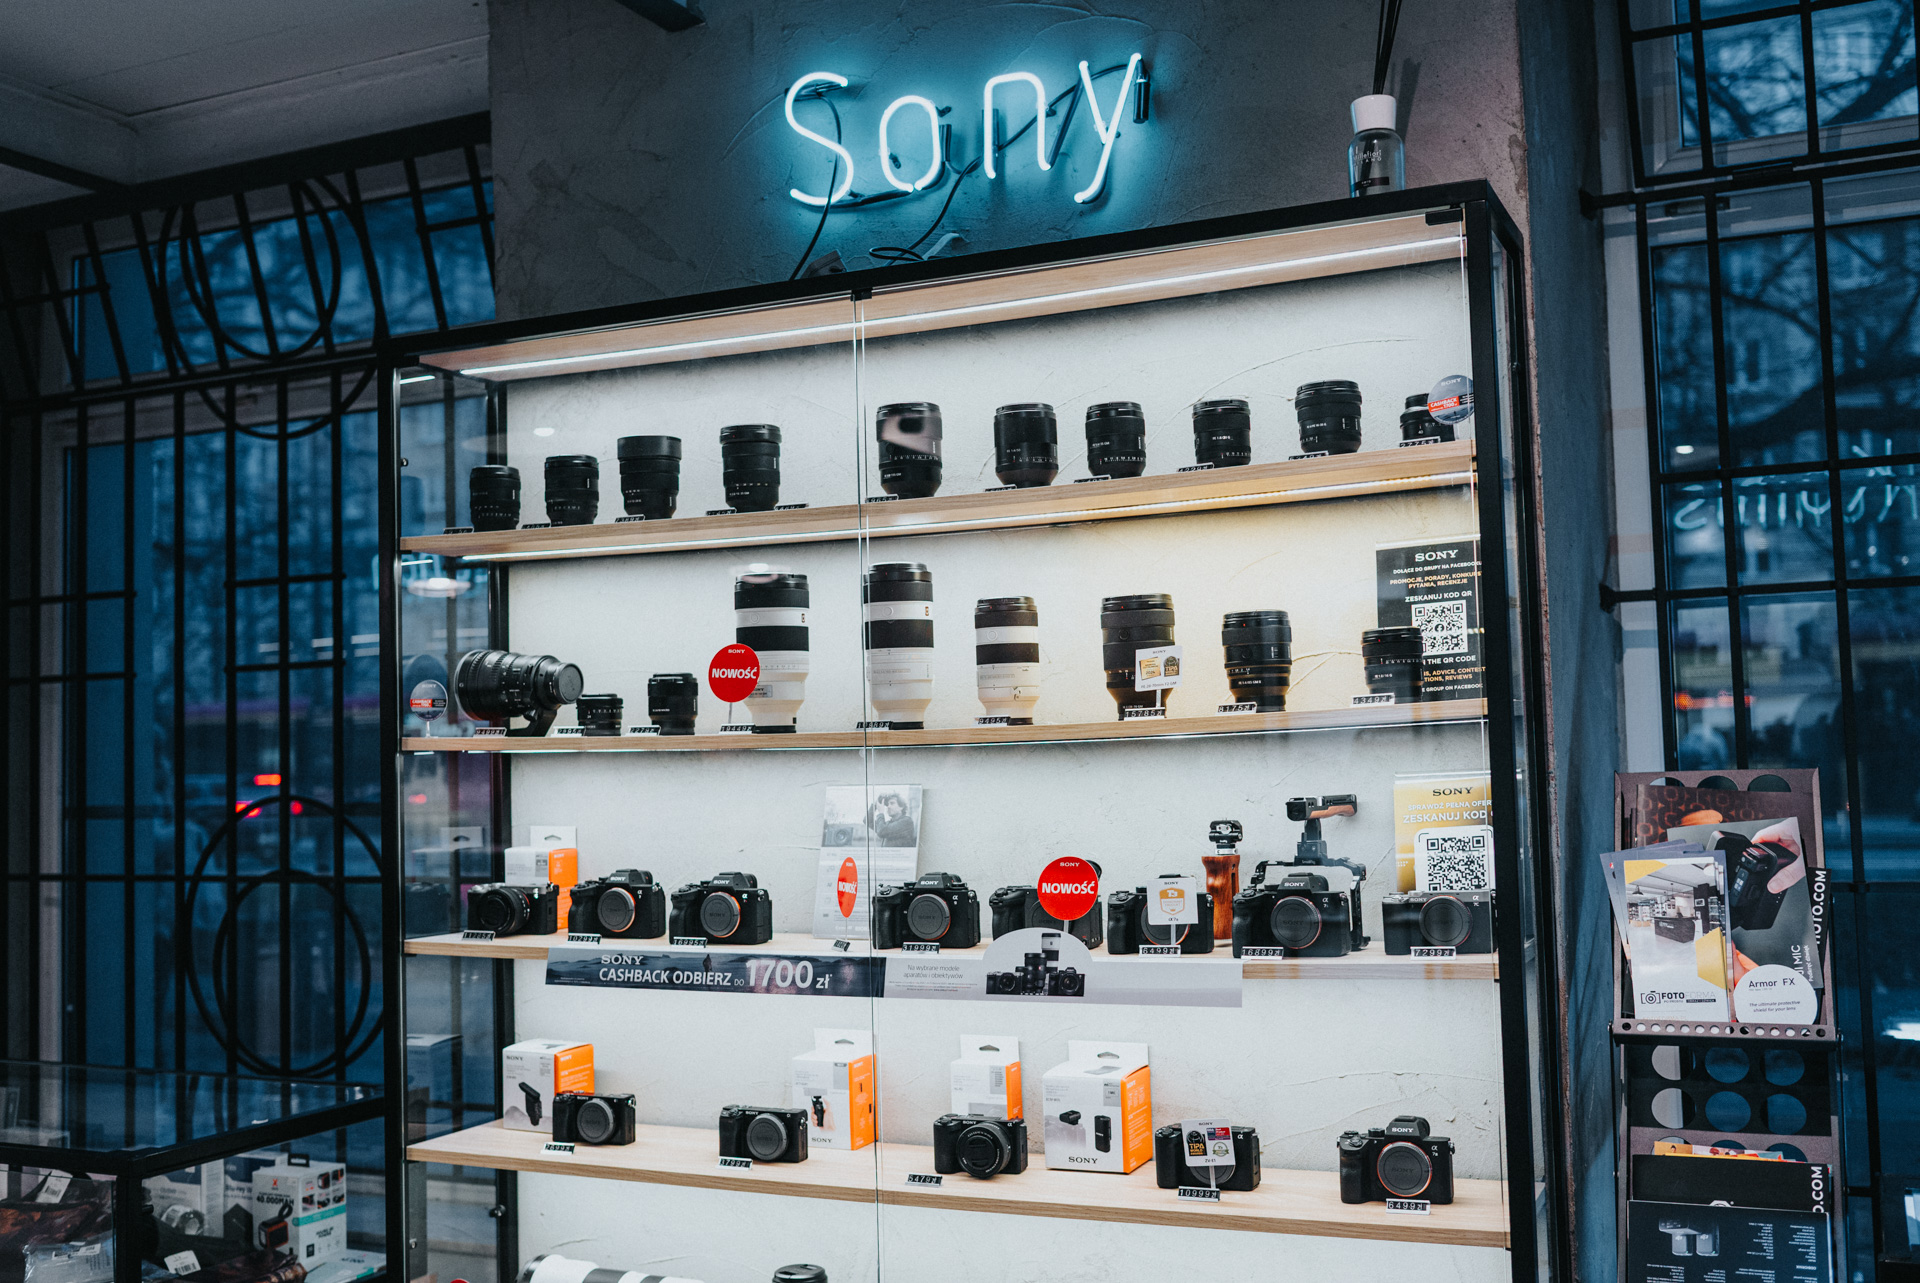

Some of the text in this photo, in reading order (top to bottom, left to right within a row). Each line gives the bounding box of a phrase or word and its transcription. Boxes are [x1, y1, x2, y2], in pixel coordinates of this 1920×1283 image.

[785, 53, 1141, 205] Sony
[1440, 377, 1462, 386] SONY
[1415, 550, 1458, 562] SONY
[1390, 577, 1423, 585] PROMOCJE,
[1405, 594, 1442, 602] ZESKANUJ
[1456, 655, 1476, 663] CODE
[711, 667, 757, 679] NOWOŚĆ
[1432, 668, 1456, 676] ADVICE,
[1433, 787, 1473, 796] SONY
[1408, 802, 1444, 811] SPRAWDŹ
[1446, 801, 1469, 809] PEŁNĄ
[1403, 810, 1487, 824] ZESKANUJ KOD
[1041, 880, 1096, 894] NOWOŚĆ
[601, 954, 644, 965] SONY
[1791, 944, 1803, 965] MIC
[599, 968, 669, 983] CASHBACK
[673, 971, 731, 986] ODBIERZ
[734, 978, 744, 986] DO
[746, 960, 813, 988] 1700
[1749, 977, 1796, 989] Armor FX
[1068, 1156, 1098, 1164] SONY
[1180, 1189, 1217, 1199] 10999zł
[1388, 1201, 1423, 1210] 6499zł
